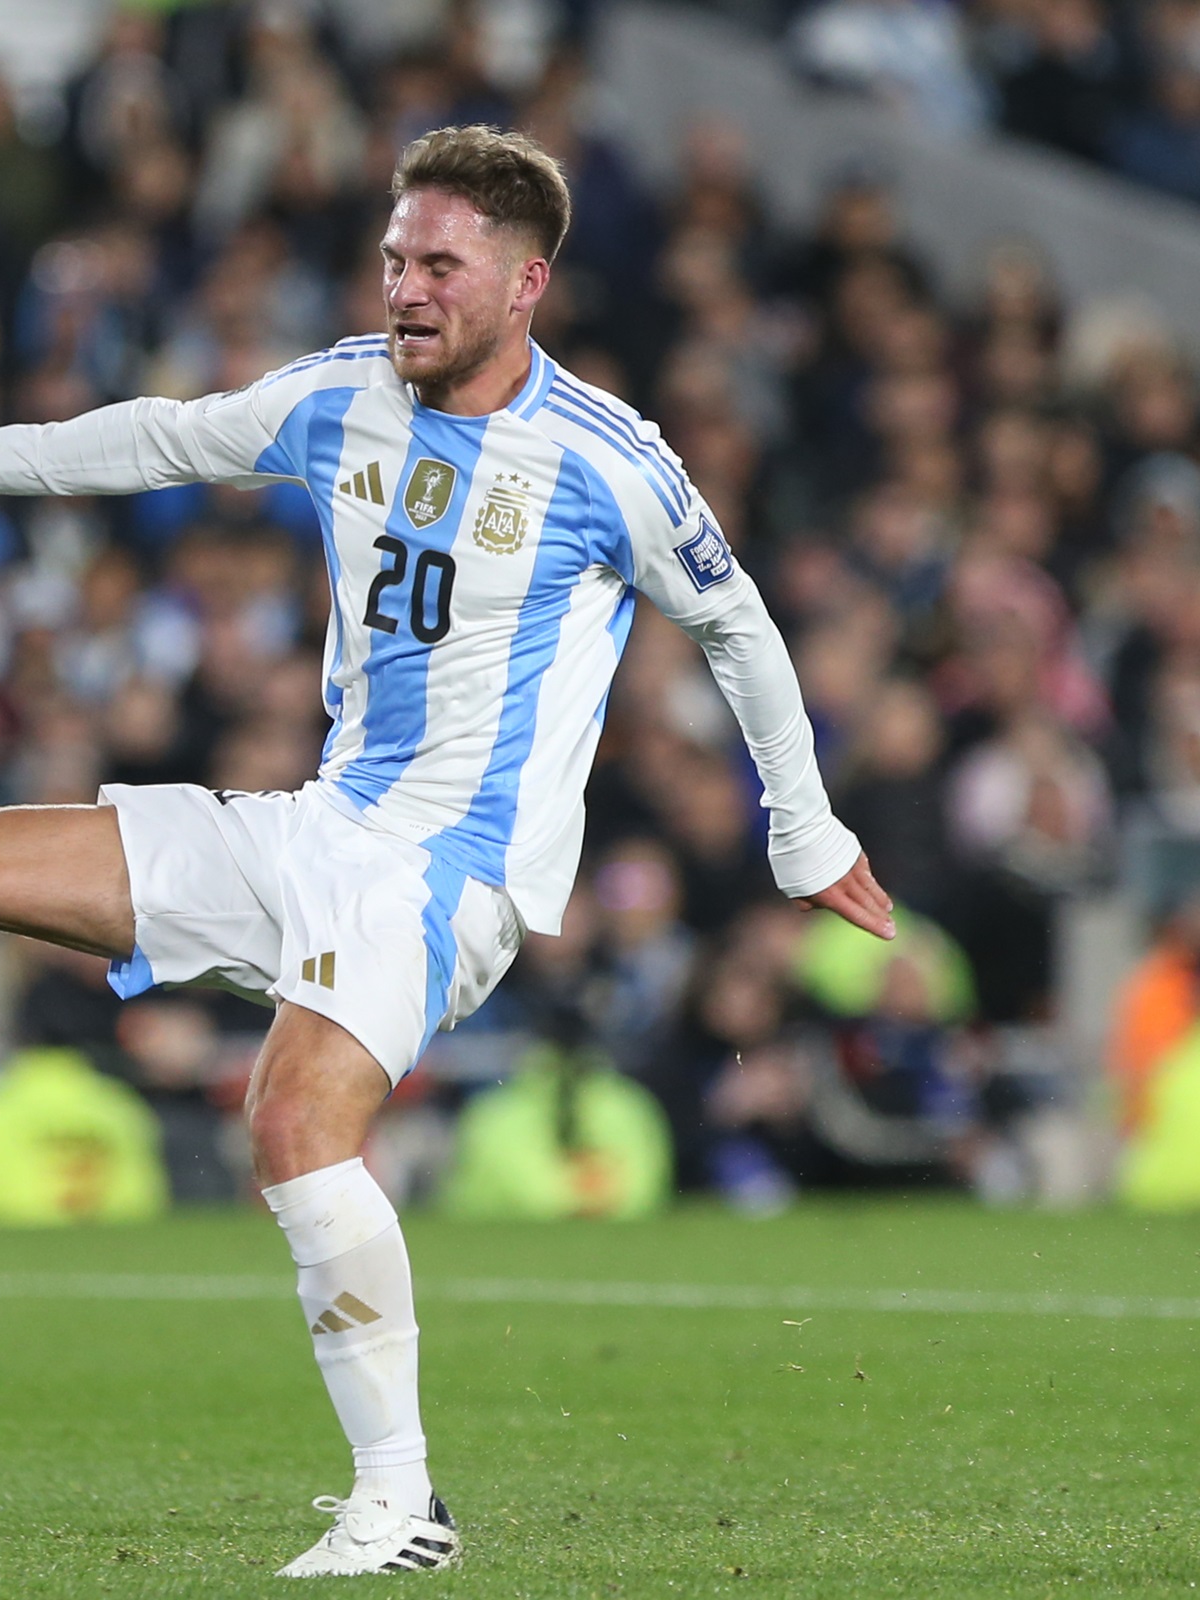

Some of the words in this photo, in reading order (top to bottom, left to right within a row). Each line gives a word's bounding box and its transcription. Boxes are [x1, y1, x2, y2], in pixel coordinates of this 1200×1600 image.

[414, 500, 434, 514] FIFA
[485, 505, 515, 537] AFA
[363, 535, 456, 644] 20
